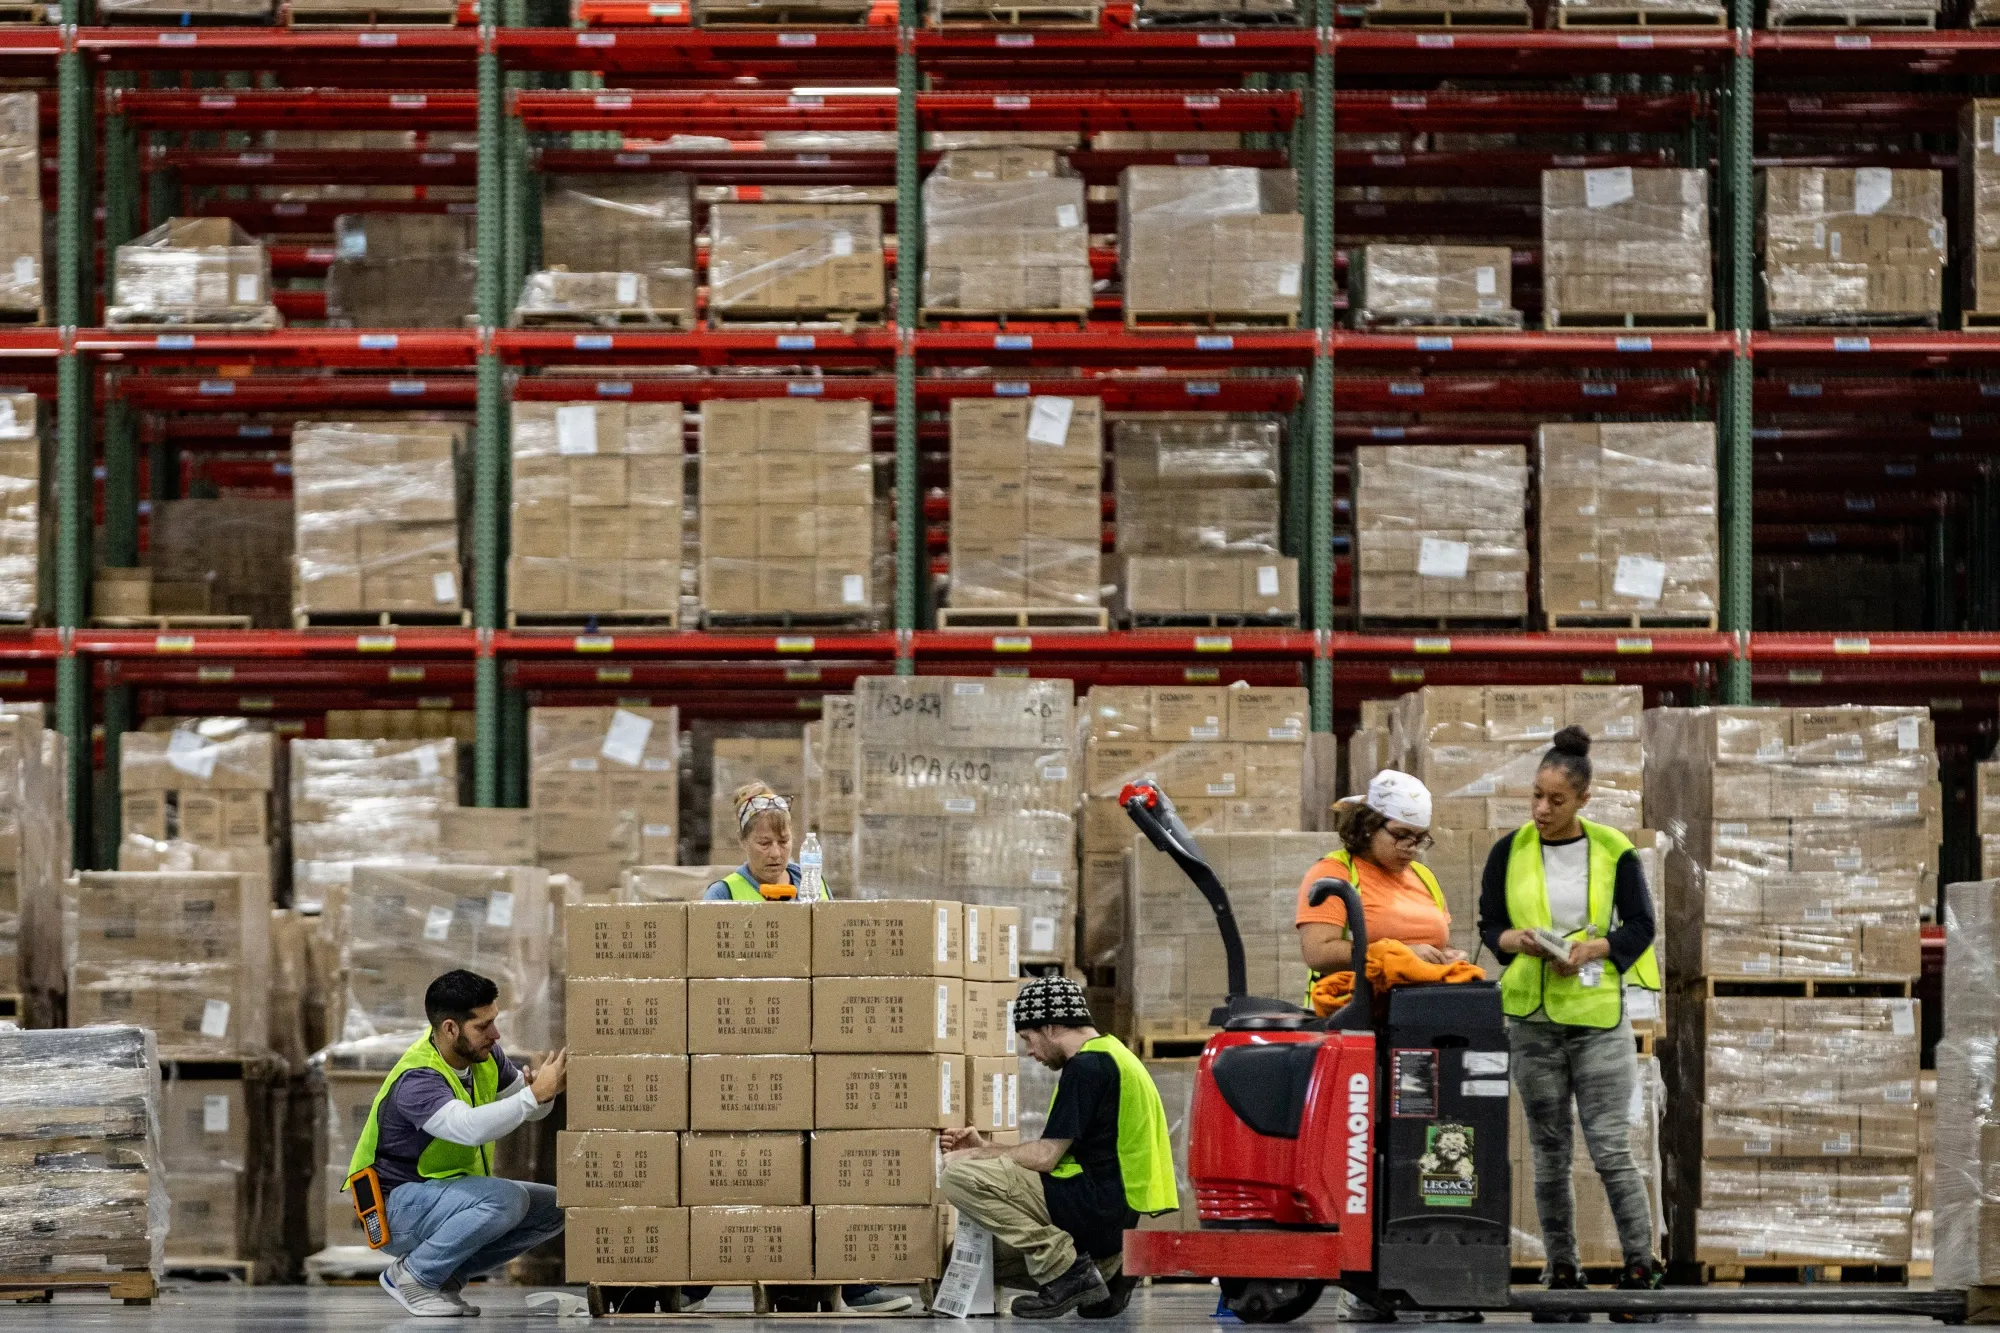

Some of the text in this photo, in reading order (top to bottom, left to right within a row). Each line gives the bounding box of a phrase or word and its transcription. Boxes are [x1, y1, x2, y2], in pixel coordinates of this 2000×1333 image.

[626, 921, 631, 929] 6
[644, 921, 657, 929] PCS
[748, 921, 753, 929] 6
[766, 921, 779, 929] PCS
[644, 931, 657, 939] LBS
[767, 931, 779, 939] LBS
[645, 941, 657, 949] LBS
[627, 998, 632, 1006] 6
[645, 998, 658, 1006] PCS
[749, 997, 754, 1005] 6
[767, 997, 780, 1005] PCS
[645, 1007, 658, 1016] LBS
[767, 1007, 780, 1015] LBS
[645, 1017, 658, 1025] LBS
[627, 1074, 632, 1082] 6
[645, 1074, 659, 1082] PCS
[751, 1073, 757, 1081] 6
[770, 1073, 783, 1081] PCS
[646, 1084, 658, 1092] LBS
[770, 1083, 783, 1091] LBS
[646, 1094, 658, 1102] LBS
[770, 1093, 783, 1101] LBS
[1347, 1072, 1370, 1214] RAYMOND
[616, 1151, 621, 1159] 6
[635, 1151, 648, 1159] PCS
[740, 1149, 746, 1157] 6
[759, 1149, 772, 1157] PCS
[635, 1160, 647, 1169] LBS
[759, 1159, 772, 1167] LBS
[635, 1170, 647, 1178] LBS
[1423, 1179, 1476, 1190] LEGACY
[627, 1226, 632, 1234] 6
[646, 1226, 659, 1234] PCS
[646, 1236, 659, 1244] LBS
